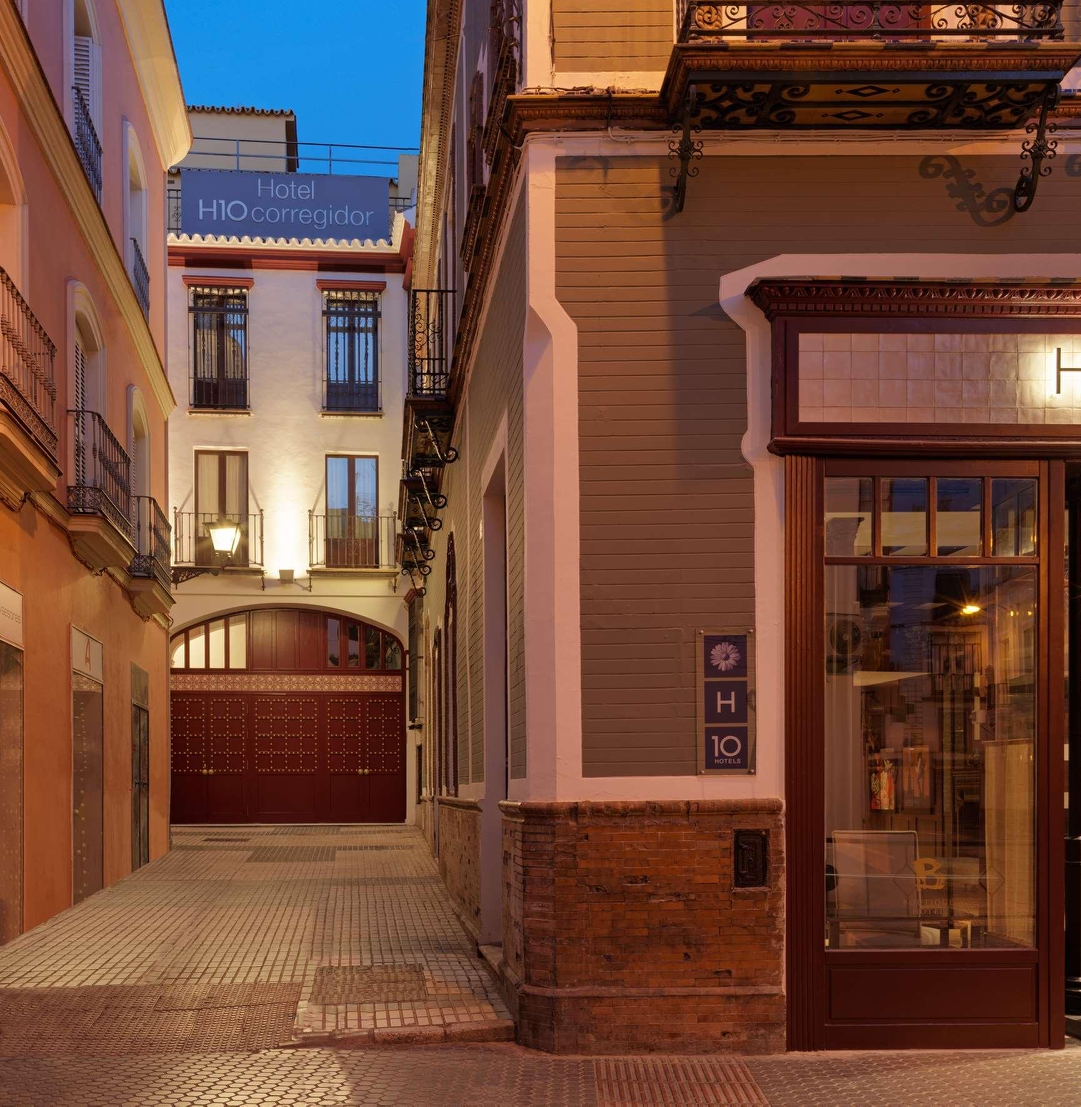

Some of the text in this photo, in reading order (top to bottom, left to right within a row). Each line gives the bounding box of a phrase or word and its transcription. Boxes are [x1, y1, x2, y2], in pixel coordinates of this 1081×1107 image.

[257, 178, 315, 200] Hotel
[199, 198, 374, 230] H10 corregidor
[716, 691, 736, 713] H
[711, 735, 742, 757] 10
[912, 857, 946, 891] B
